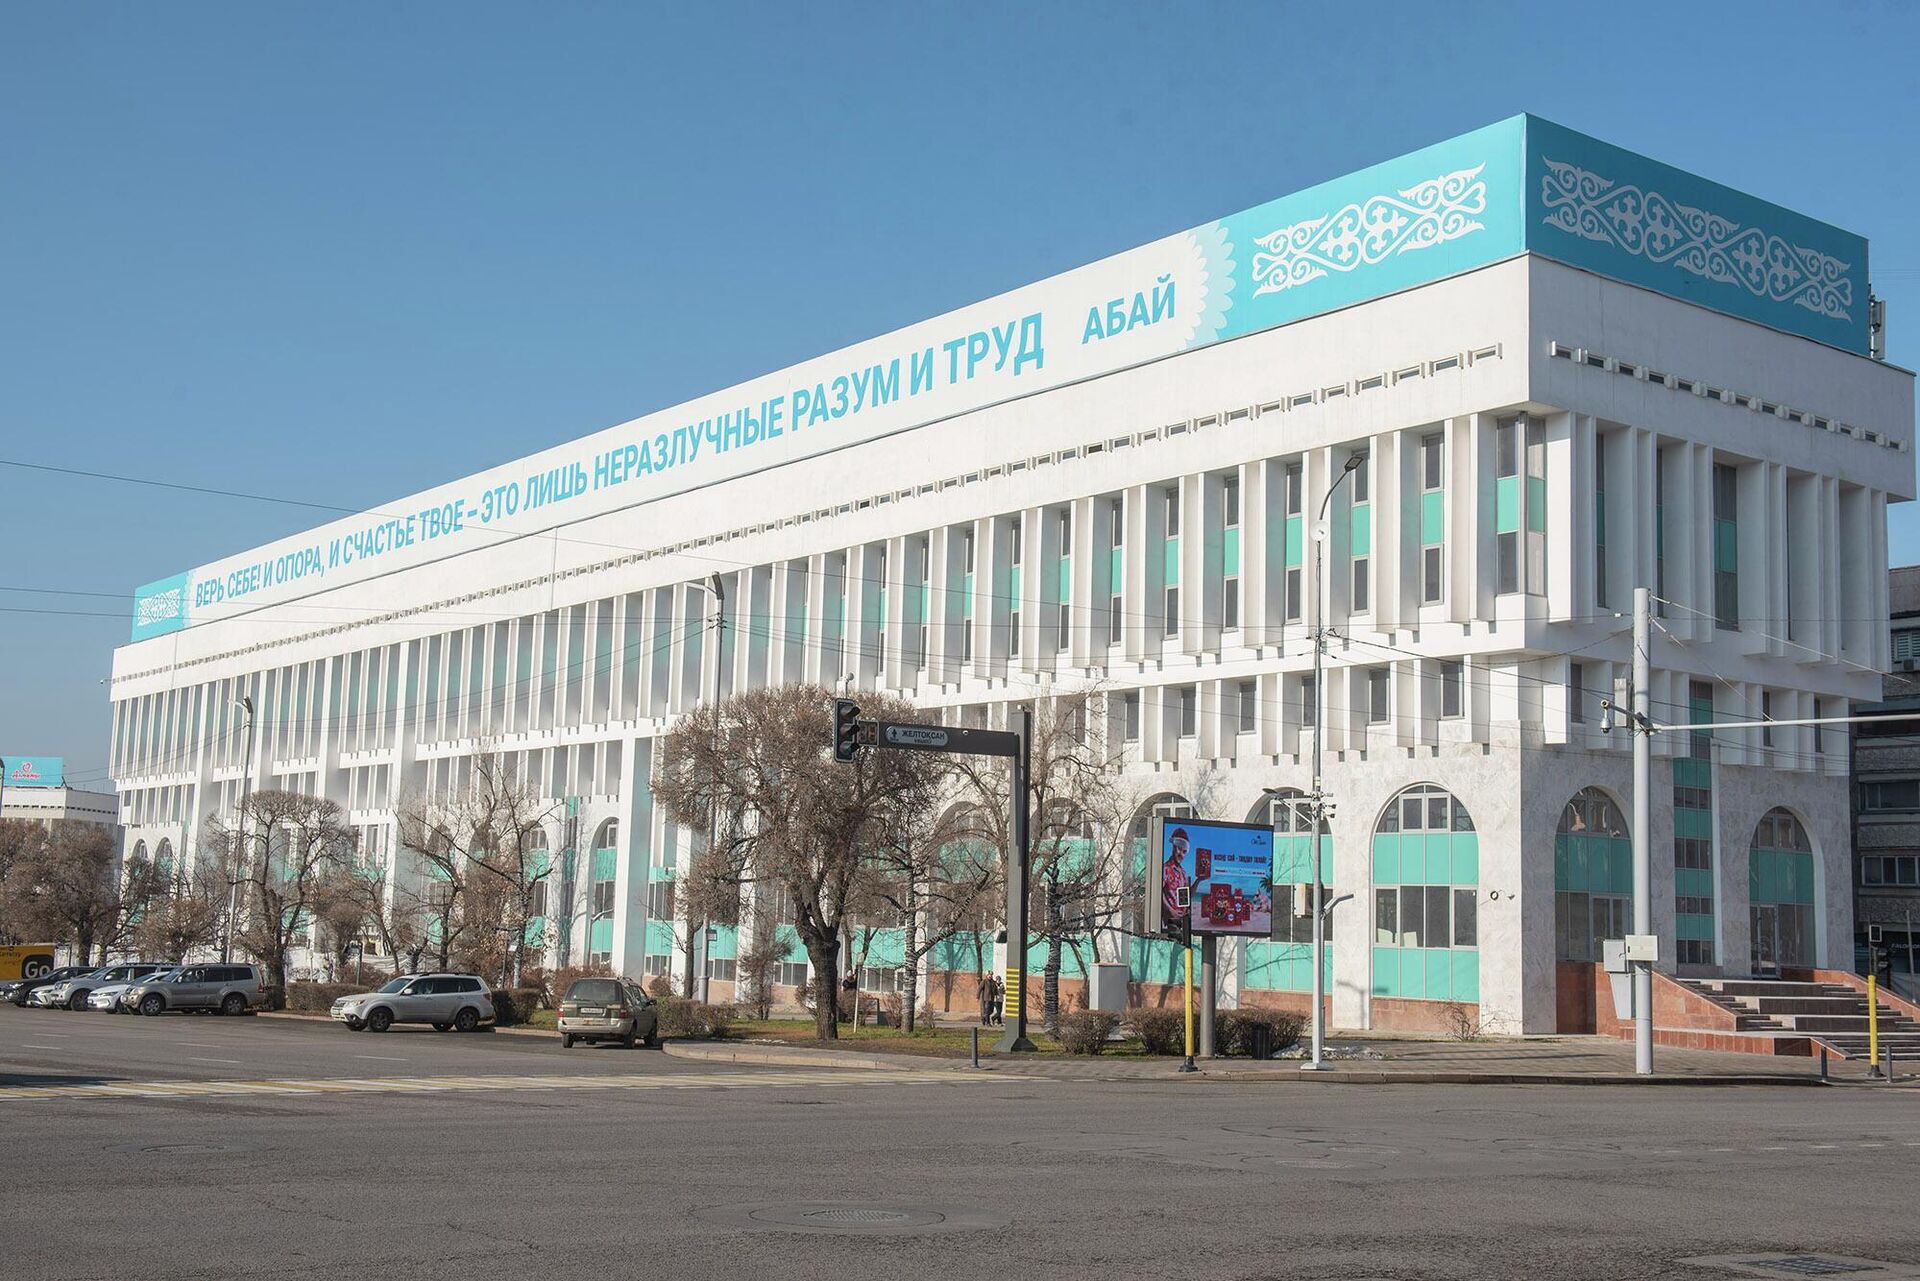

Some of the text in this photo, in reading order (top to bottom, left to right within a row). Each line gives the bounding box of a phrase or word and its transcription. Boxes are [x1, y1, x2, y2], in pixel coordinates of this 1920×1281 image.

[195, 576, 224, 608] ВЕРЬ
[227, 564, 261, 599] СЕБЕ!
[263, 559, 273, 588] И
[276, 545, 325, 585] ОПОРА,
[329, 538, 341, 569] И
[343, 514, 416, 565] СЧАСТЬЕ
[419, 499, 465, 542] ТВОЕ
[481, 482, 519, 524] ЭТО
[523, 461, 588, 512] ЛИШЬ
[594, 395, 785, 490] НЕРАЗЛУЧНЫЕ
[792, 358, 901, 431] РАЗУМ
[910, 347, 934, 396] И
[943, 312, 1044, 385] ТРУД
[1081, 273, 1176, 345] АБАЙ
